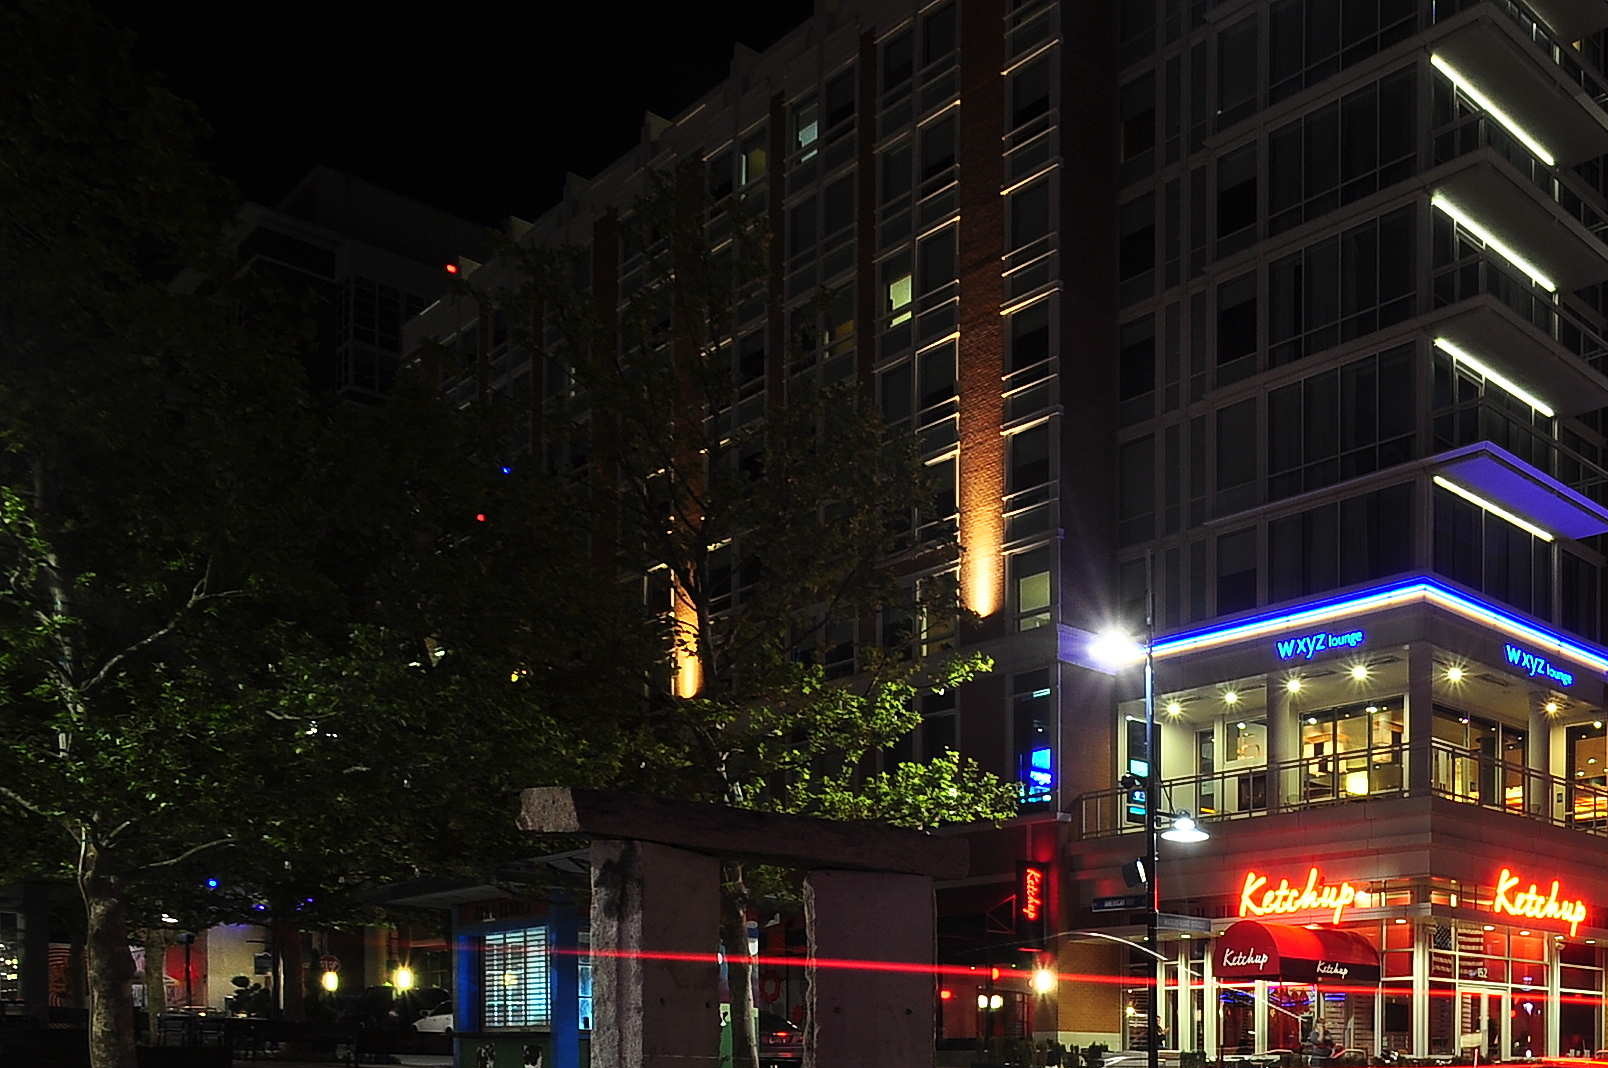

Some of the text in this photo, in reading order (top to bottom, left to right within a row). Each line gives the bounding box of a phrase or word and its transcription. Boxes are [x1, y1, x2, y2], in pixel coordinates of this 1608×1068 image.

[1328, 631, 1363, 647] lounge
[1022, 867, 1042, 921] Ketchup
[1238, 867, 1356, 925] Ketchup
[1493, 868, 1587, 937] Ketchup
[1222, 947, 1269, 971] Ketchup
[1316, 959, 1349, 980] Ketchup
